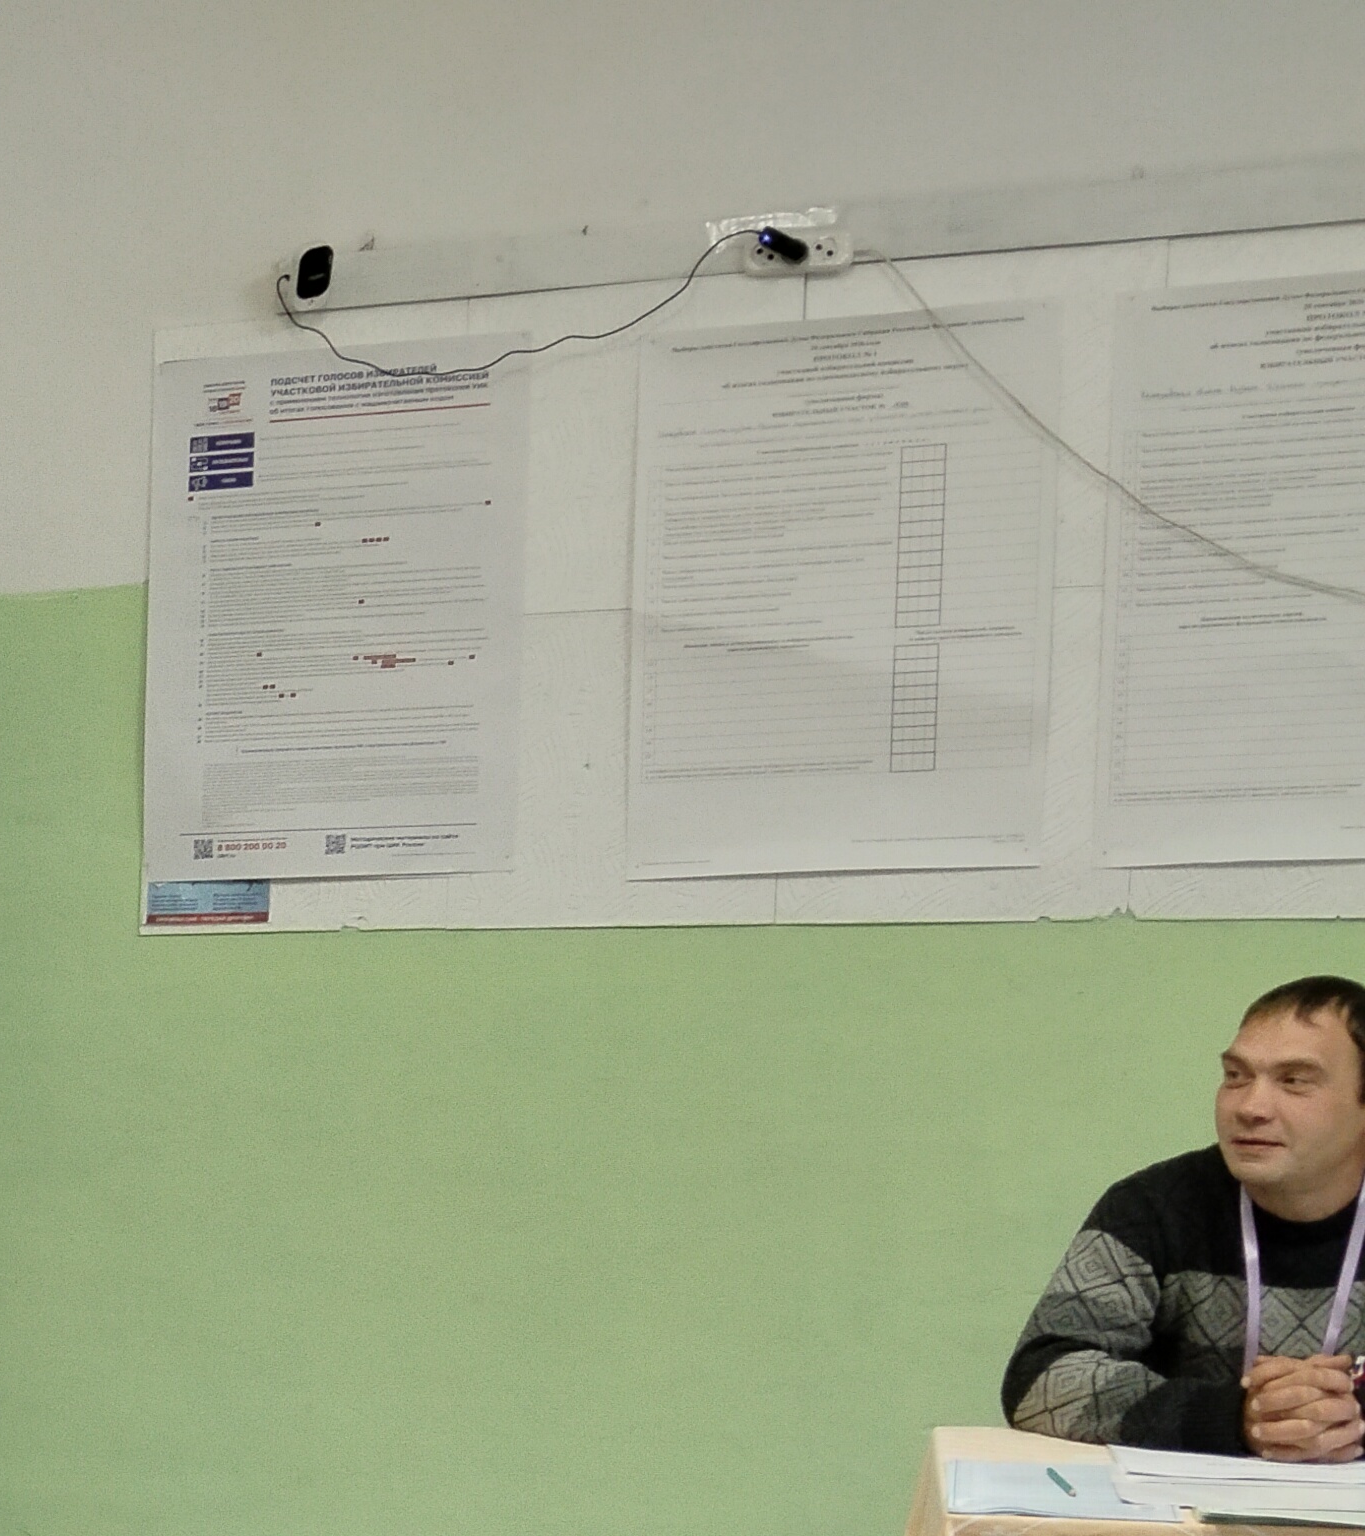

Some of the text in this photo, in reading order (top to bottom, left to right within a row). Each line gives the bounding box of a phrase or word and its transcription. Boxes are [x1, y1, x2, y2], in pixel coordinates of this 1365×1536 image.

[271, 375, 316, 386] ПОДСЧЕТ
[318, 371, 364, 382] ГОЛОСОВ
[271, 370, 489, 397] УЧАСТКОВОЙ ИЗБИРАТЕЛЬНОЙ КОМИССИЕЙ
